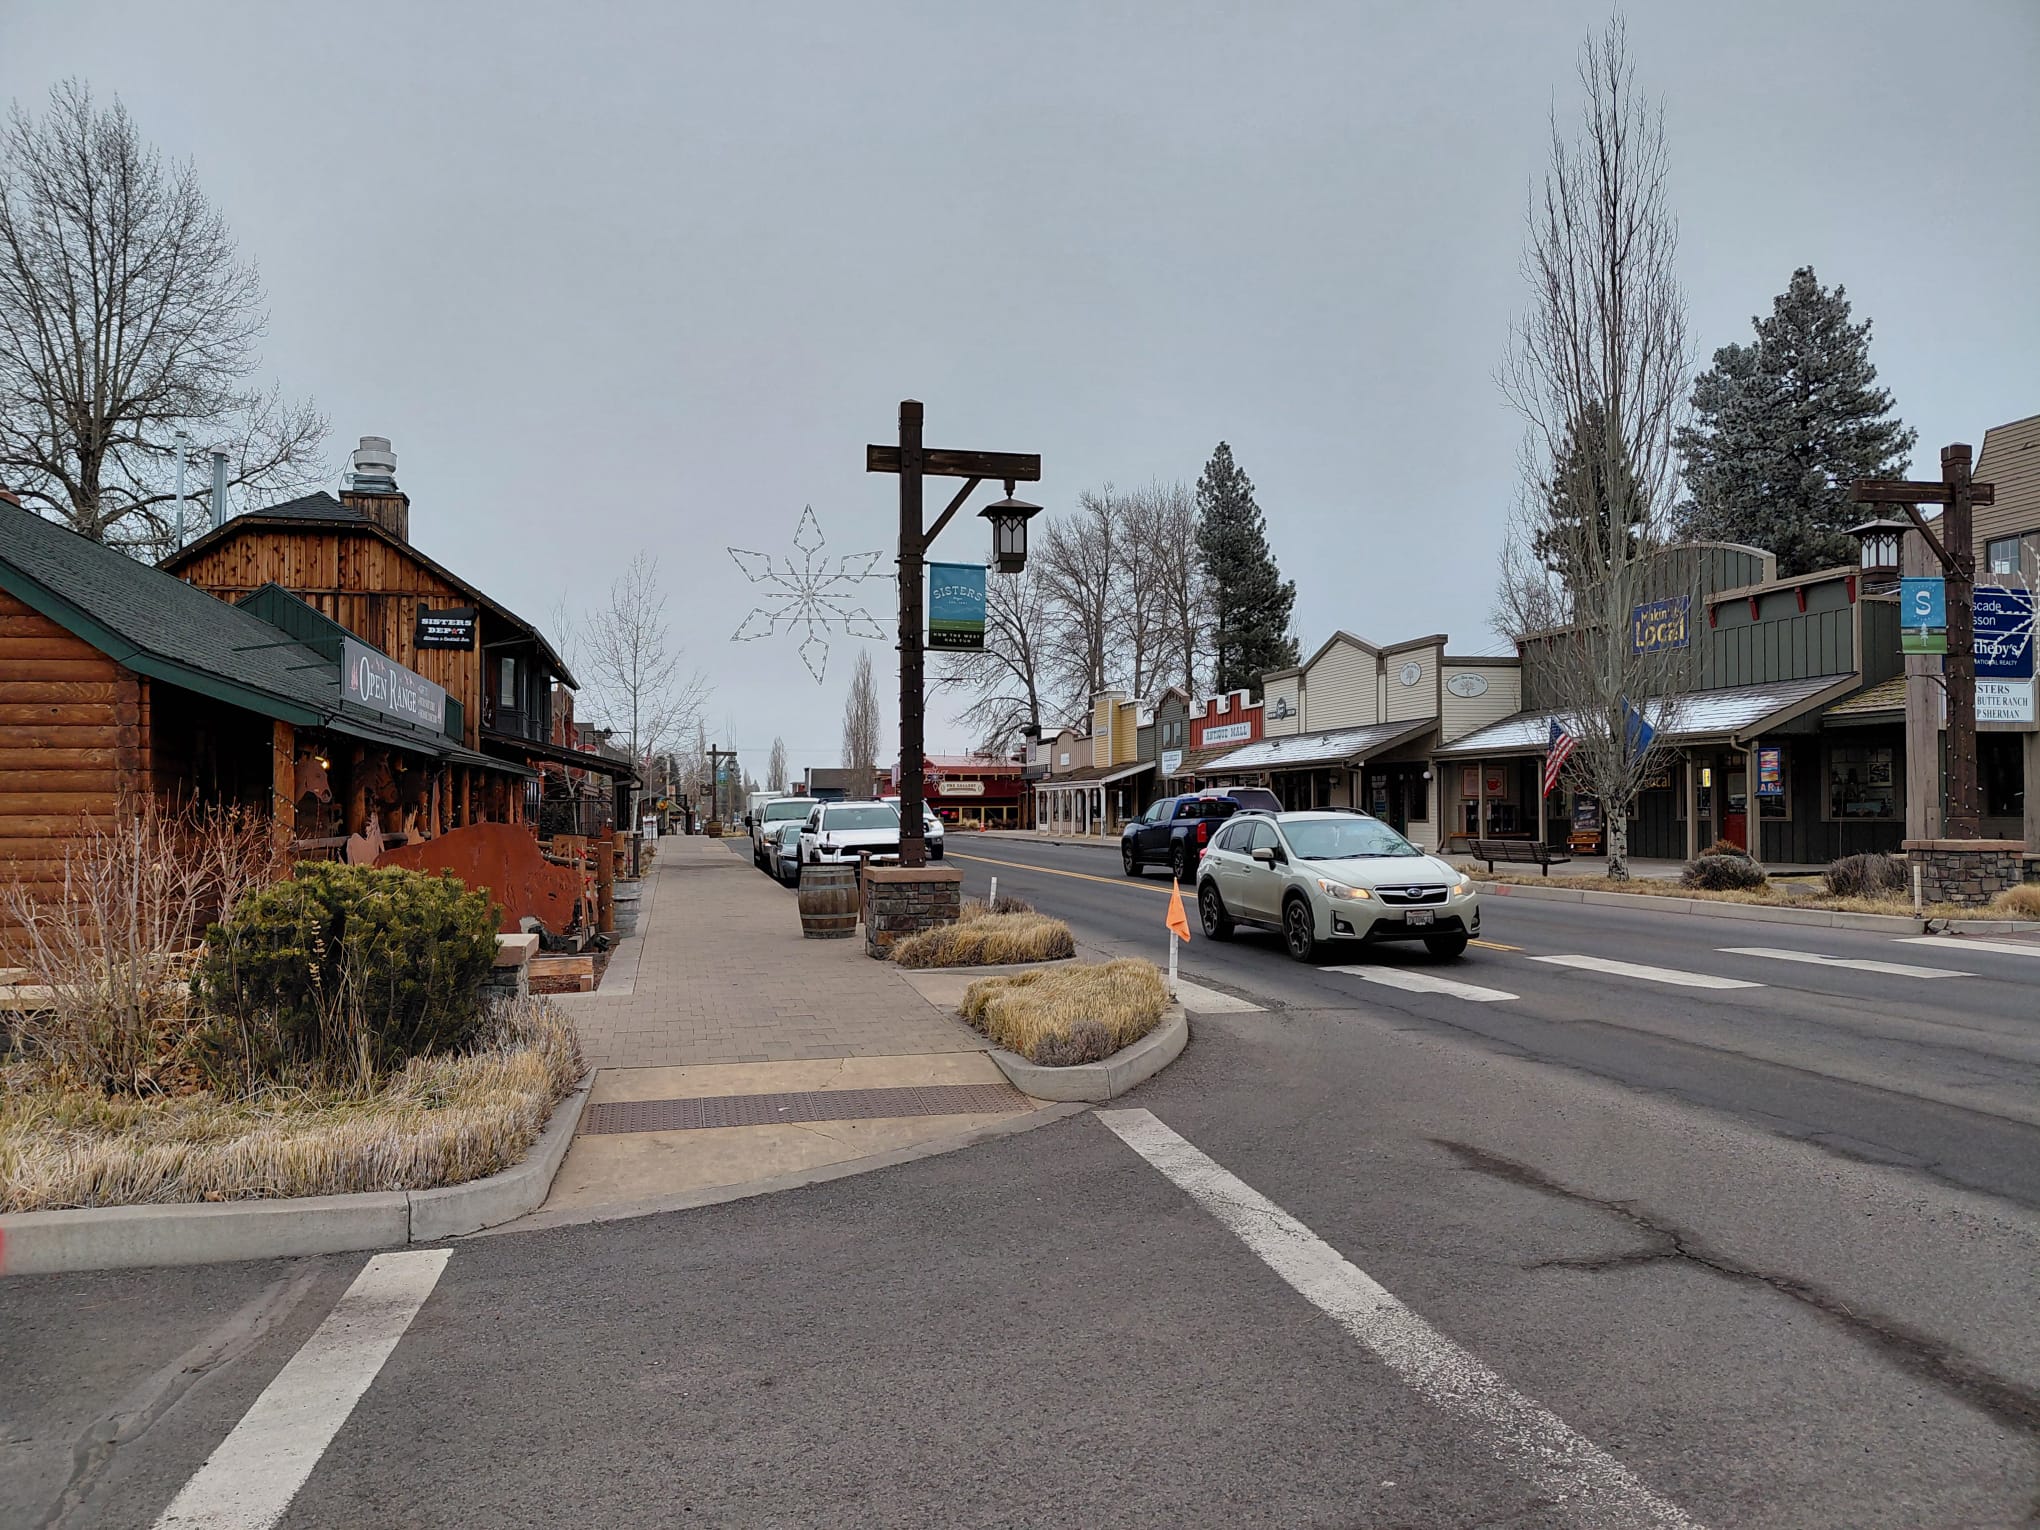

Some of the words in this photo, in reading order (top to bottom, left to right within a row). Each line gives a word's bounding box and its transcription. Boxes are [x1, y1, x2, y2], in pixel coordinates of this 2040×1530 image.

[933, 586, 982, 601] SISTERS
[1915, 591, 1931, 615] S
[1973, 600, 2002, 611] scade
[421, 618, 472, 626] SISTERS
[1973, 616, 1996, 626] sson
[1974, 641, 2018, 658] theby's
[1977, 684, 2010, 695] STERS
[1977, 696, 2001, 706] BUTTE
[2002, 697, 2028, 707] RANCH
[1983, 709, 2020, 719] SHERMAN
[1206, 729, 1228, 741] ANTIQUE
[1230, 725, 1247, 737] MALL
[1760, 782, 1784, 793] ART
